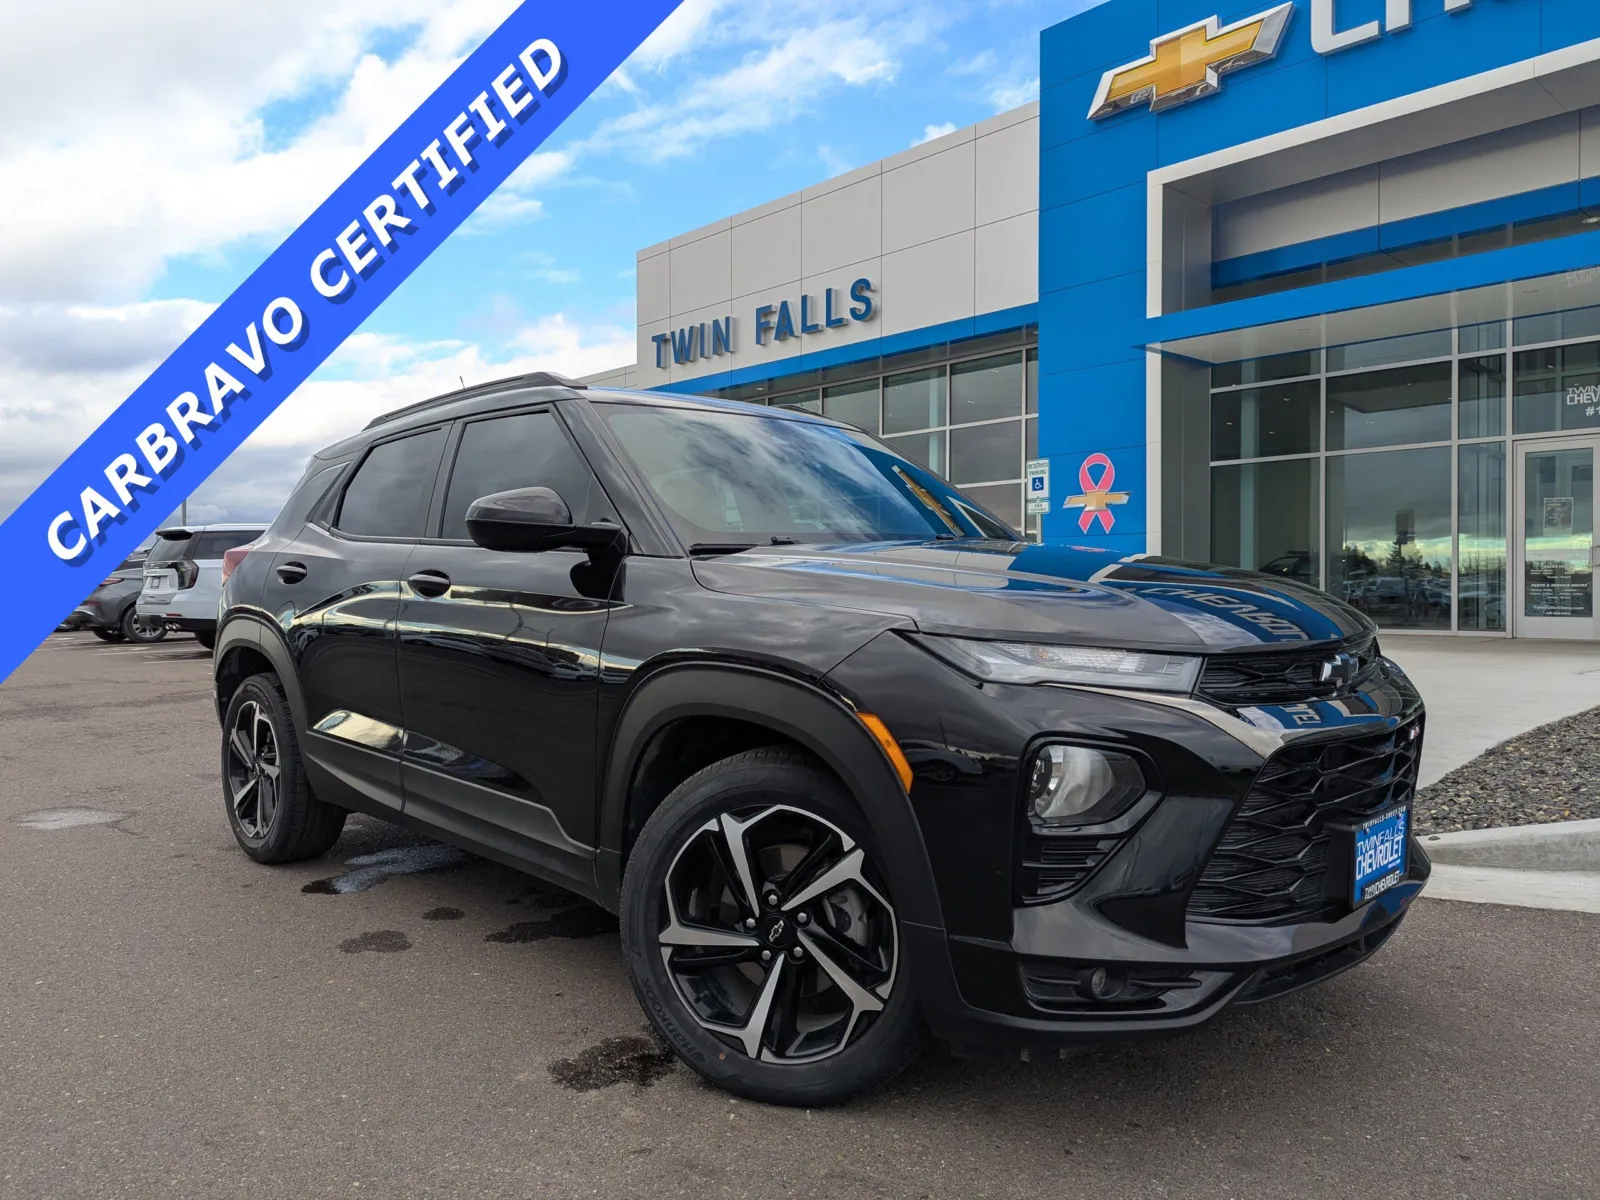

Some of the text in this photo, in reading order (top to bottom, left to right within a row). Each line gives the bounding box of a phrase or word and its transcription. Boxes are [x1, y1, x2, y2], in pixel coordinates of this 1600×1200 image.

[651, 277, 878, 369] TWIN FALLS
[1355, 834, 1404, 881] CHEVROLET
